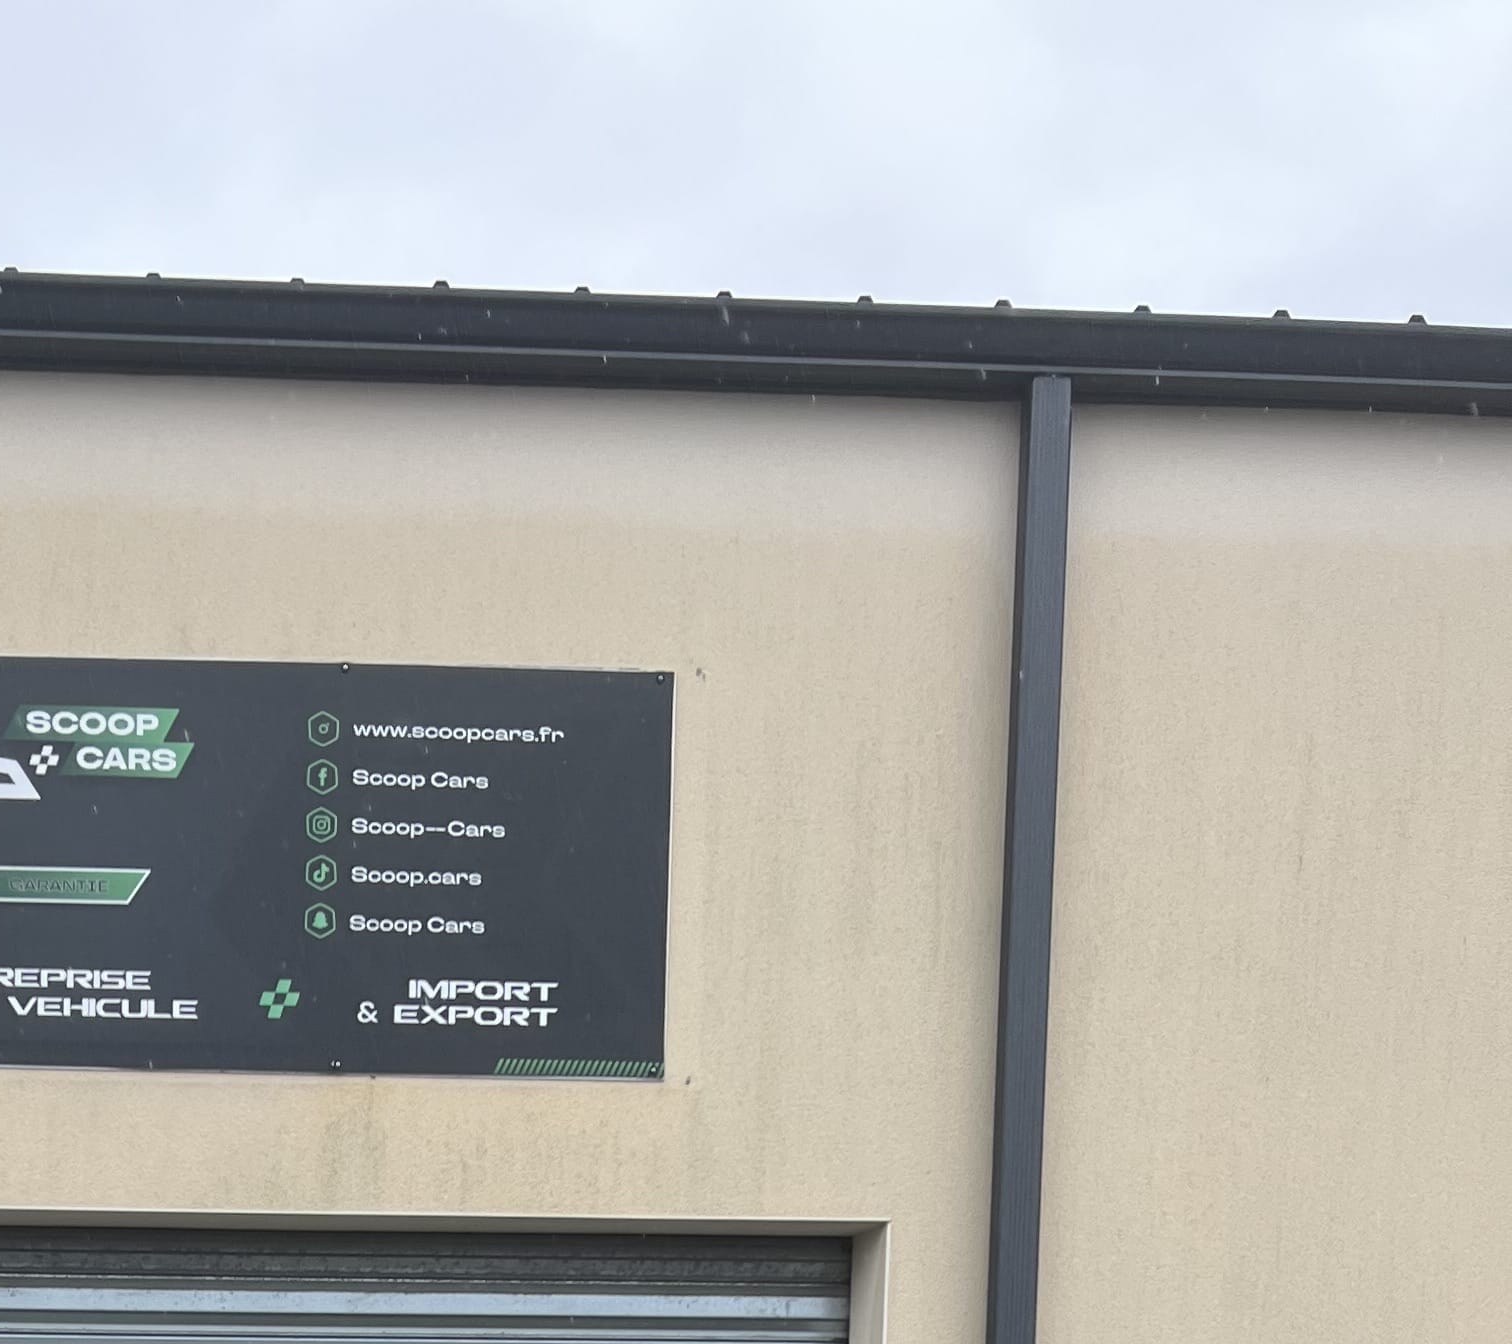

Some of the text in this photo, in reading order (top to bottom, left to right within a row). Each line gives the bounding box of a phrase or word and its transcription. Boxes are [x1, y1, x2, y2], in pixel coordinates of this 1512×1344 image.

[25, 710, 160, 737] SCOOP
[352, 723, 565, 744] www.scoopcars.fr
[75, 746, 178, 772] CARS
[351, 768, 490, 790] Scoop Cars
[8, 878, 110, 894] GARANTIE
[350, 865, 483, 887] Scoop.cars
[348, 914, 486, 936] Scoop Cars
[408, 978, 559, 1002] IMPORT
[6, 995, 199, 1020] VEHICULE
[356, 1000, 559, 1028] & EXPORT
